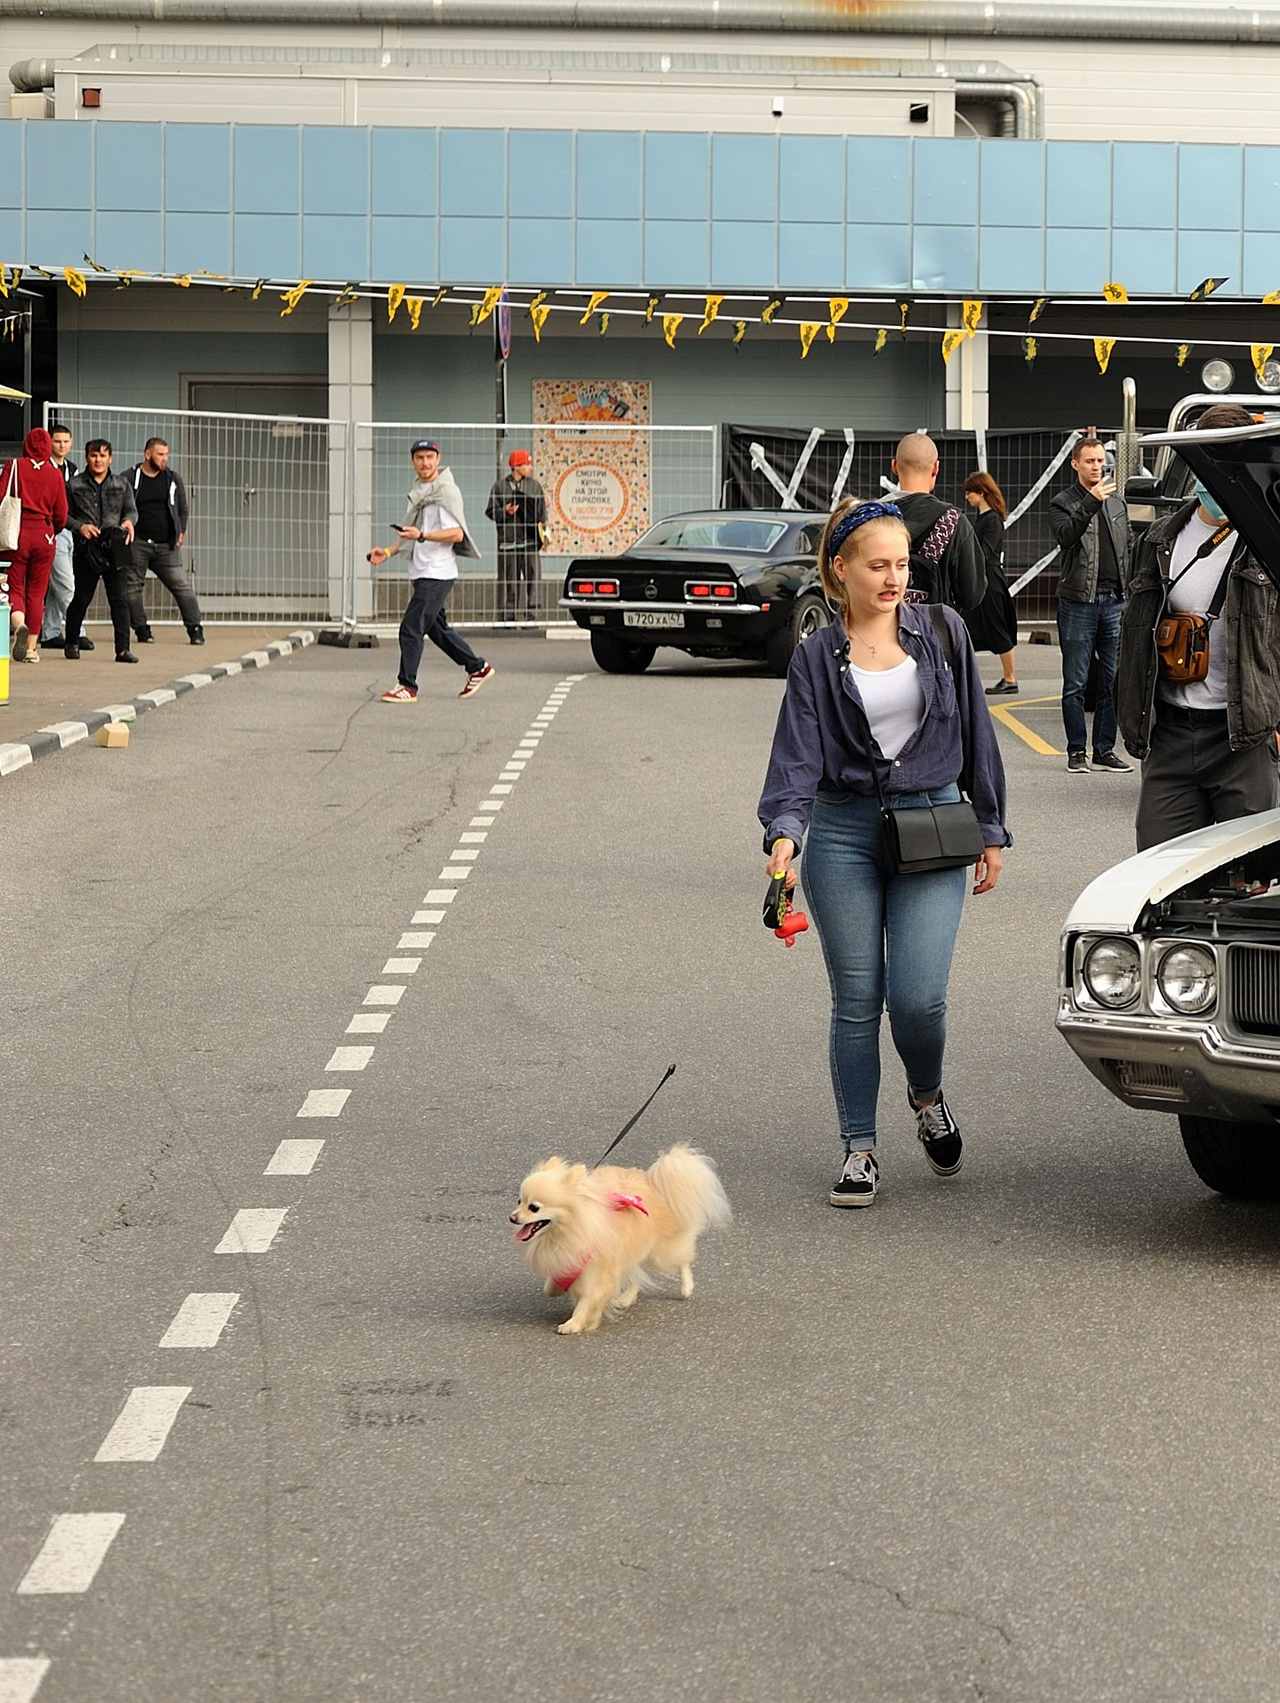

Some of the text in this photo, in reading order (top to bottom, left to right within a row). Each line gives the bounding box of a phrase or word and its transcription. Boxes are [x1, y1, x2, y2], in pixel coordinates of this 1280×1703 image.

[588, 487, 607, 495] ЭТОЙ
[571, 496, 611, 504] ПАРКОВКЕ
[1212, 527, 1230, 545] Nikon
